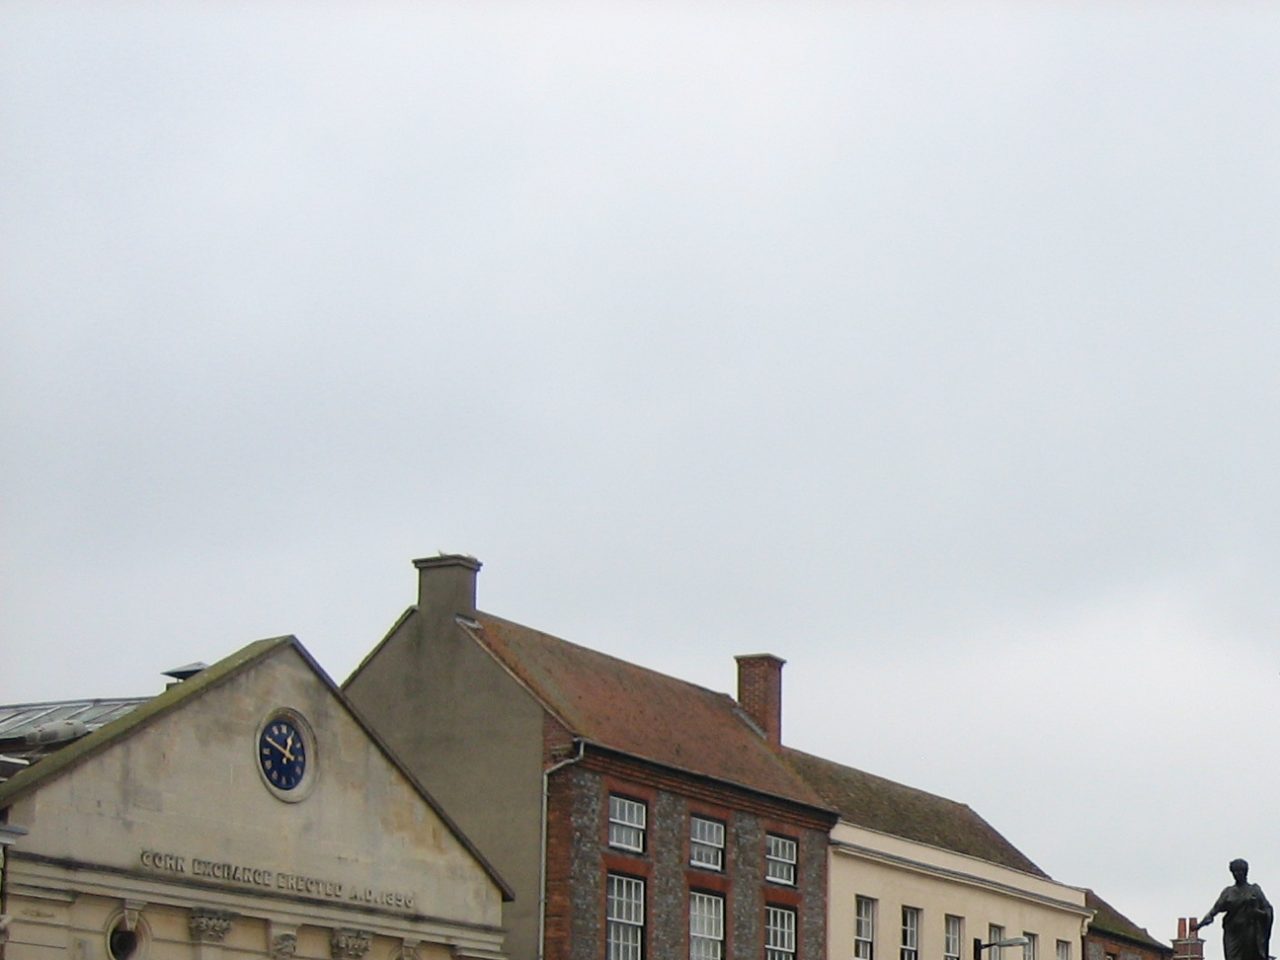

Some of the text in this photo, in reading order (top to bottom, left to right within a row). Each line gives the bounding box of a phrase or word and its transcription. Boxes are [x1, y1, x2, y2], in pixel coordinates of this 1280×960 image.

[140, 850, 185, 873] CORN
[192, 858, 272, 887] EXCHANGE
[277, 872, 342, 898] ERECTED
